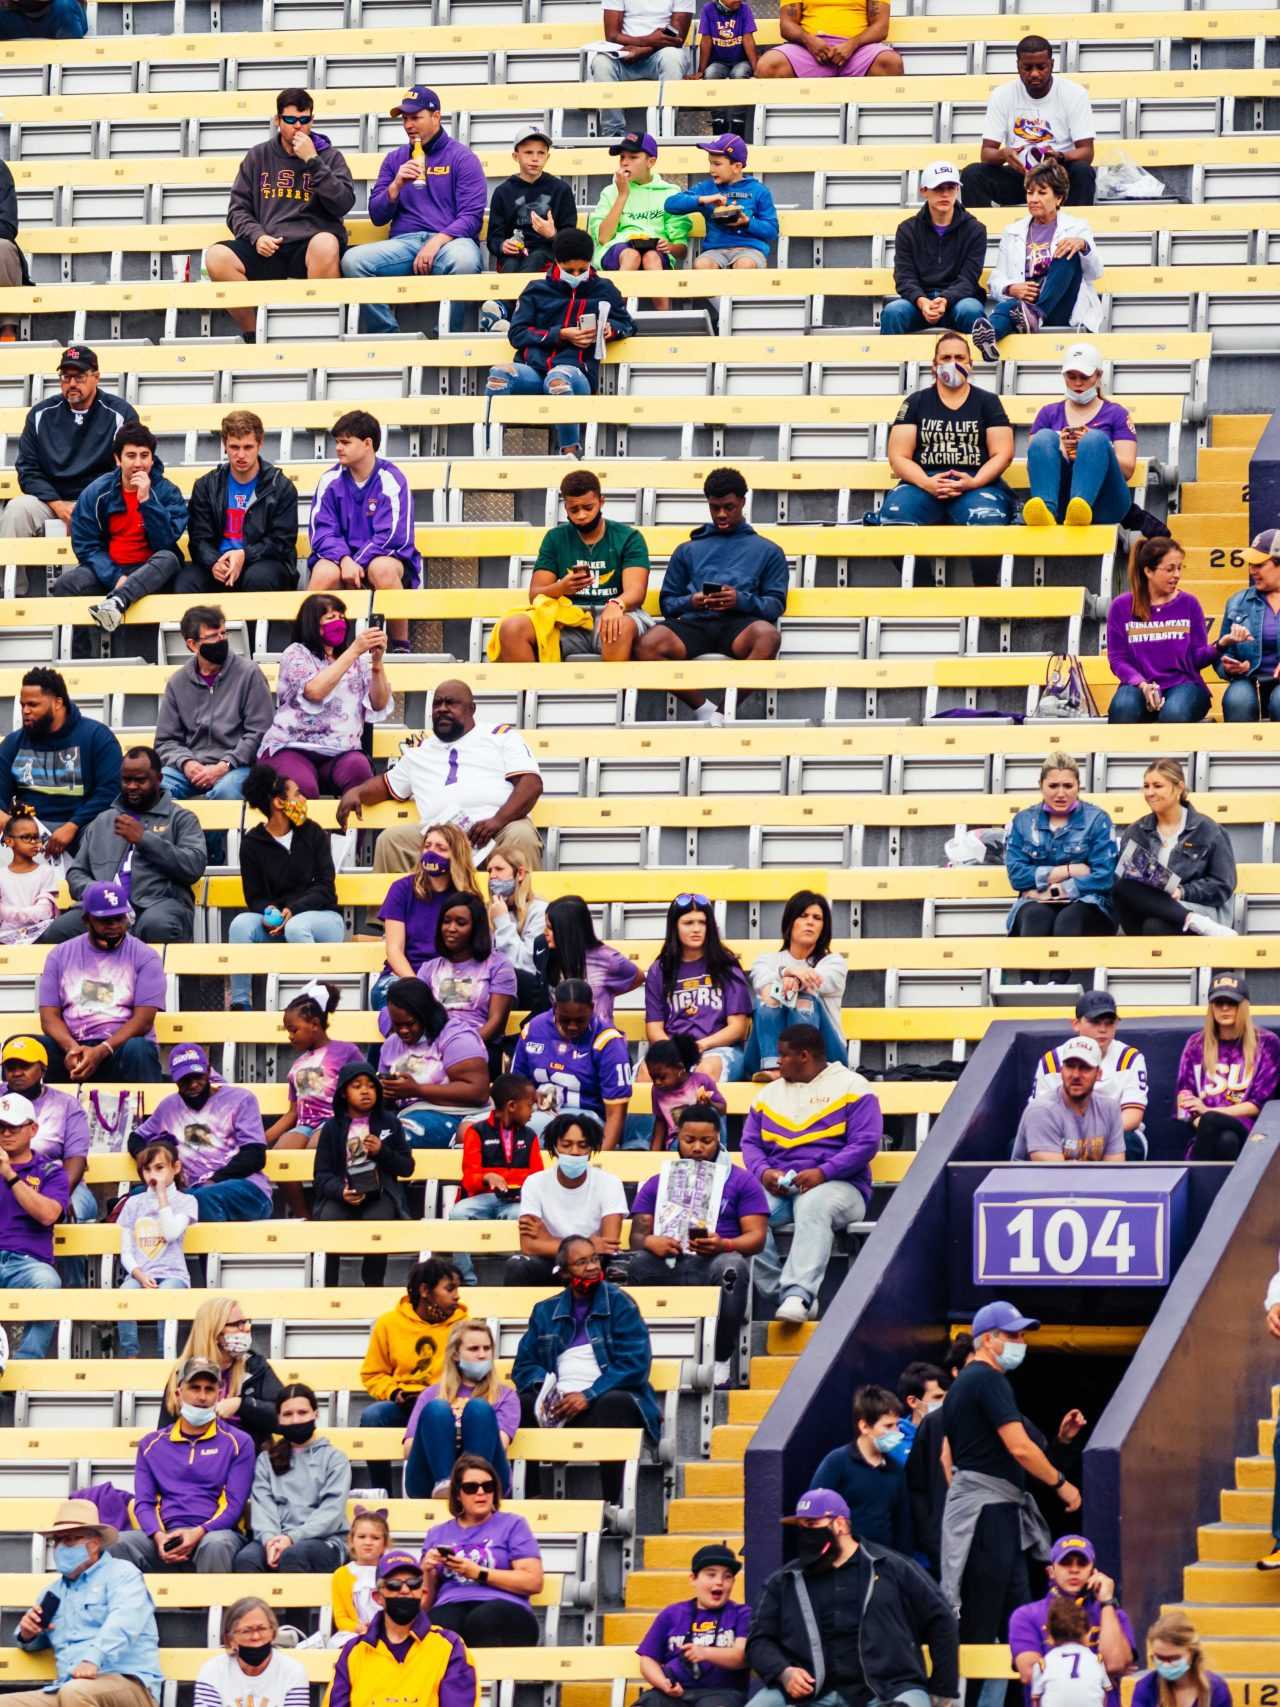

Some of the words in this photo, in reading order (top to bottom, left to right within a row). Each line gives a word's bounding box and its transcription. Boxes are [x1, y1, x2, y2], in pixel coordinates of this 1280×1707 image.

[427, 166, 449, 175] LSU
[934, 166, 953, 175] LSU
[263, 187, 311, 202] TIGERS
[922, 418, 943, 432] LIVE
[945, 420, 953, 432] A
[956, 420, 979, 433] LIFE
[921, 432, 979, 445] WORTH
[920, 452, 981, 466] SACRIFICE
[1210, 549, 1245, 568] 26
[598, 587, 618, 596] FIELD
[1165, 619, 1191, 630] STATE
[1128, 631, 1186, 643] UNIVERSITY
[445, 748, 459, 786] 1
[1214, 977, 1238, 988] LSU
[549, 1061, 565, 1072] LSU
[1194, 1062, 1253, 1096] LSU
[1006, 1208, 1136, 1273] 104
[691, 1621, 716, 1633] LSU
[1062, 1653, 1081, 1679] 7
[1244, 1683, 1278, 1706] 12
